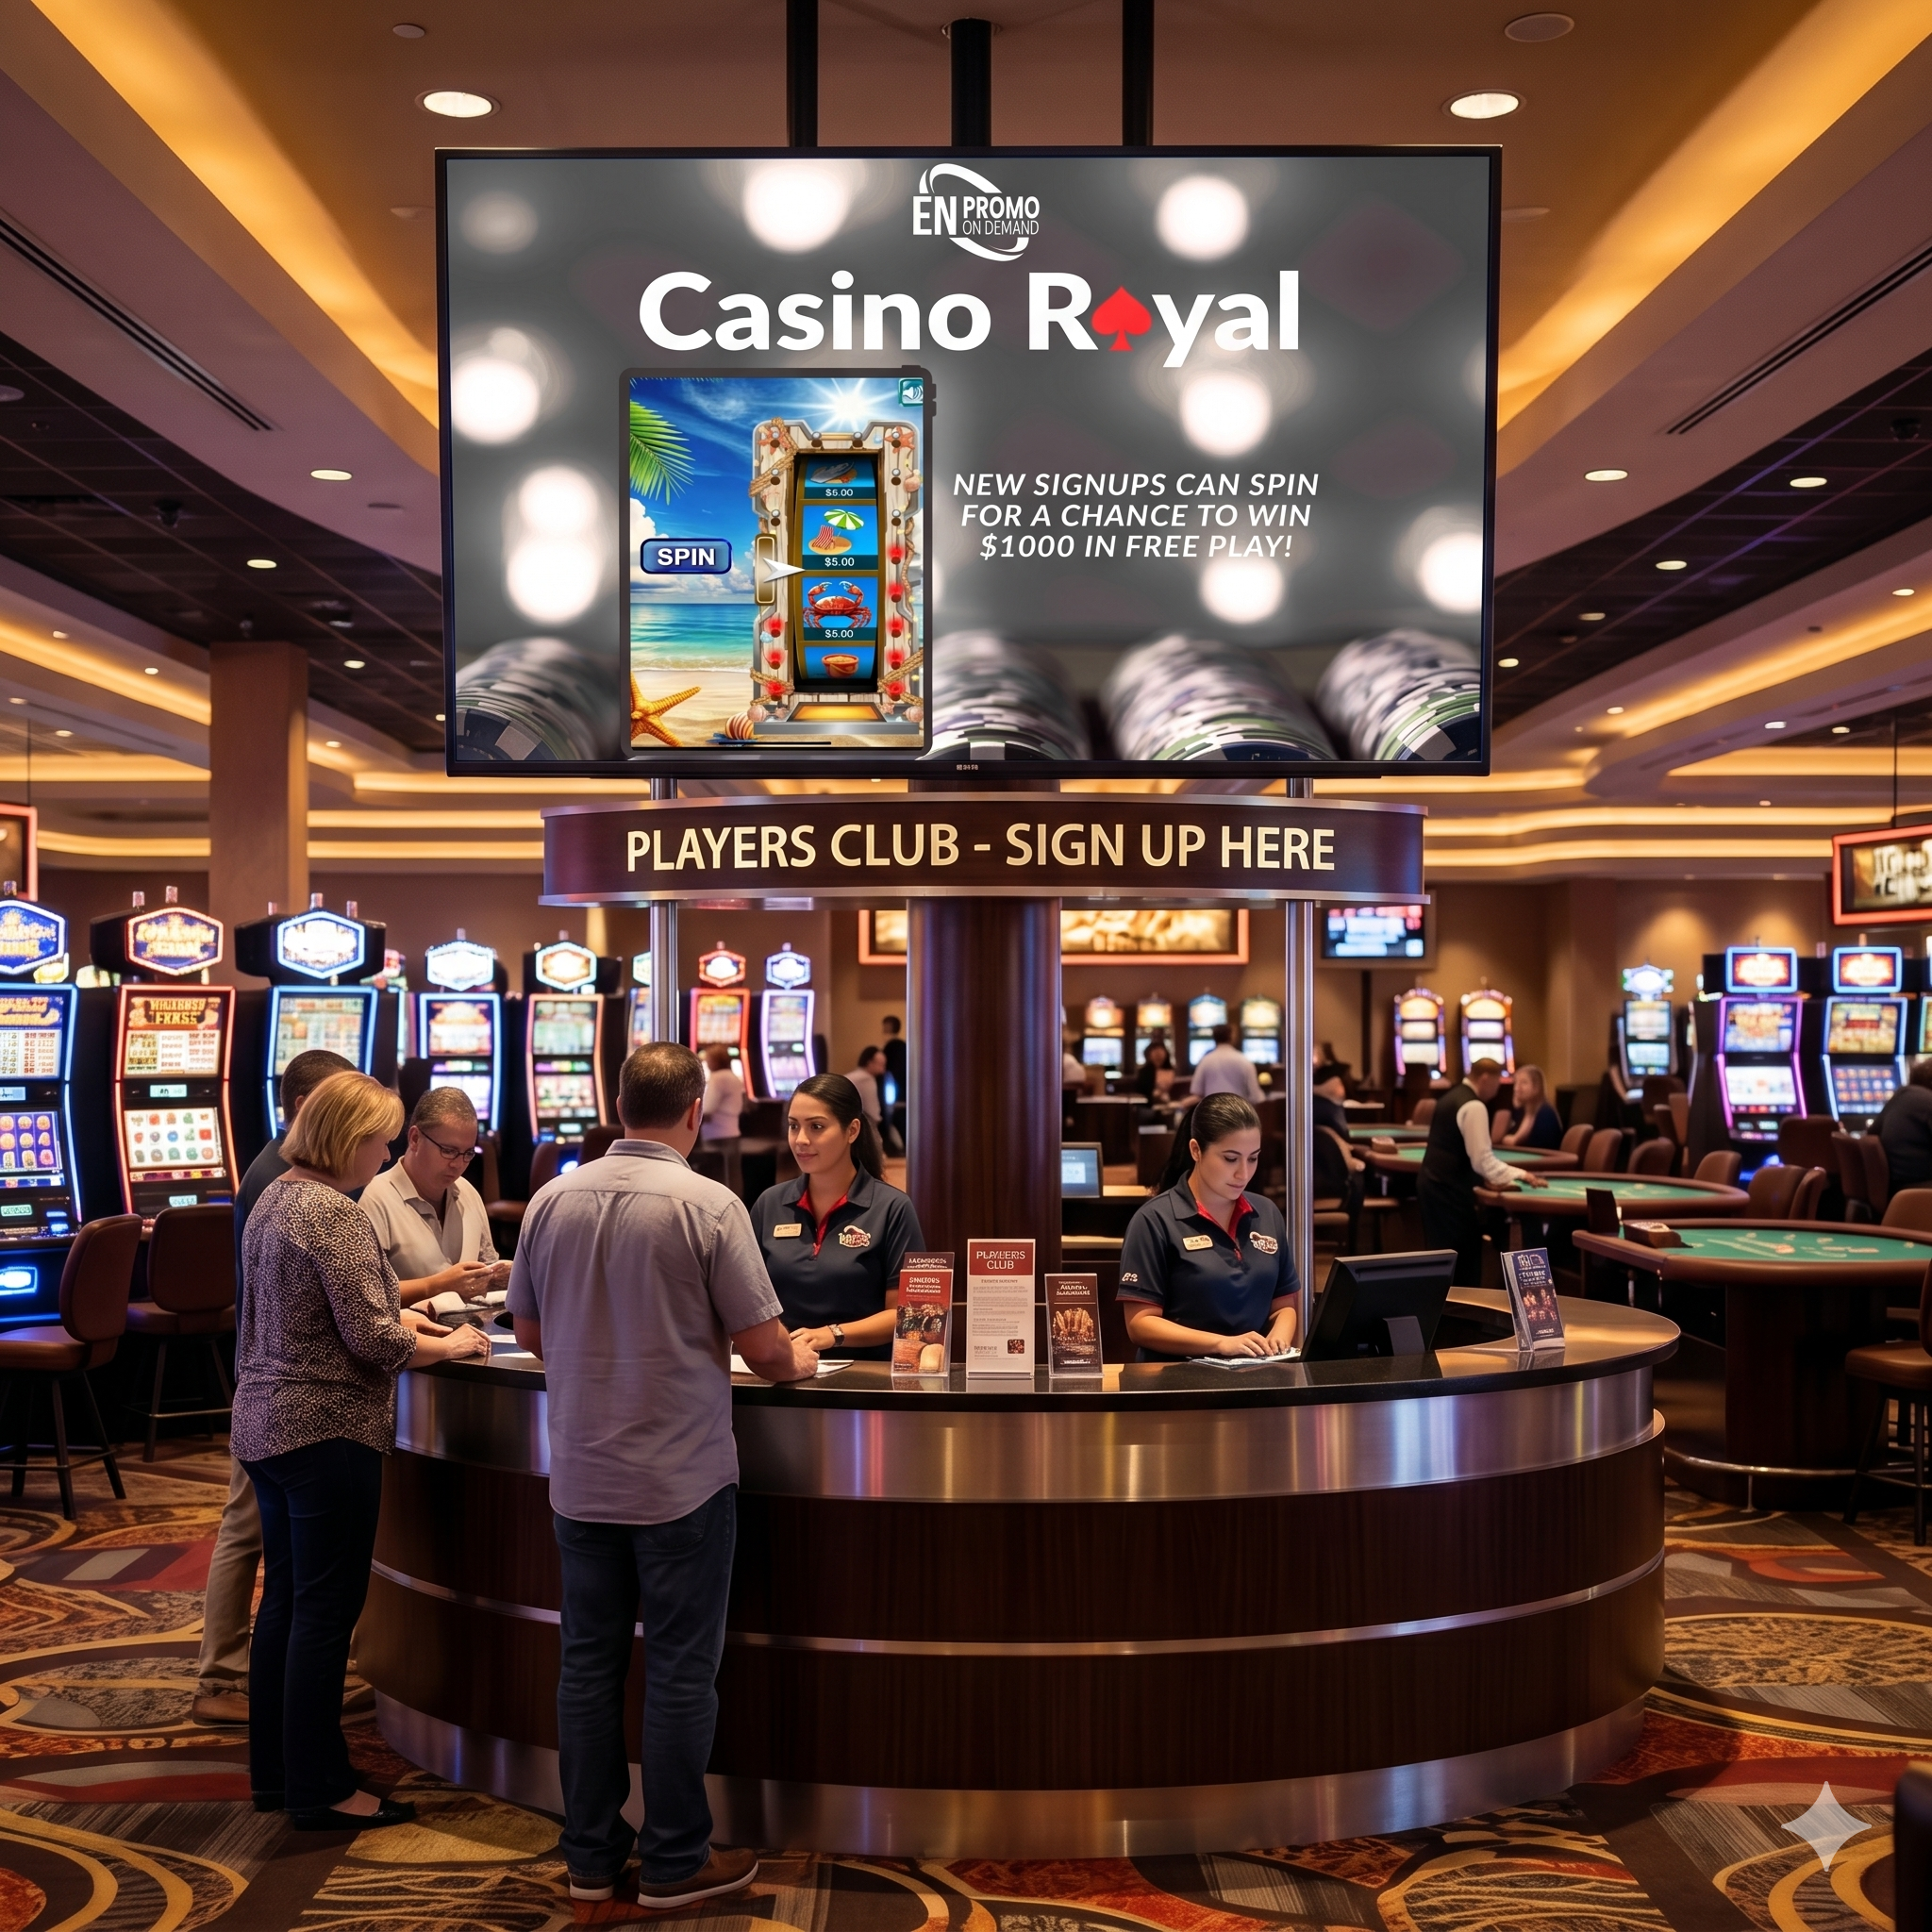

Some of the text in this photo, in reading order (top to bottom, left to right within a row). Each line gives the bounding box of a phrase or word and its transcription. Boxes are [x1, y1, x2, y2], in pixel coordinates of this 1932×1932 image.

[912, 195, 1041, 236] EN PROMO
[962, 220, 1040, 236] ON DEMAND
[639, 270, 1300, 368] Casino Ryal
[953, 473, 1319, 496] NEW SIGNUPS CAN SPIN
[960, 504, 1311, 527] FOR A CHANCE TO WIN
[657, 547, 716, 566] SPIN
[979, 532, 1292, 560] $1000 IN FREE PLAY!
[824, 557, 855, 567] $5.00
[824, 628, 854, 639] $5.00
[627, 824, 817, 873] PLAYERS
[830, 824, 959, 867] CLUB
[1006, 823, 1124, 866] SIGN
[1141, 824, 1207, 867] UP
[1221, 825, 1336, 871] HERE
[986, 1259, 1015, 1270] CLUB
